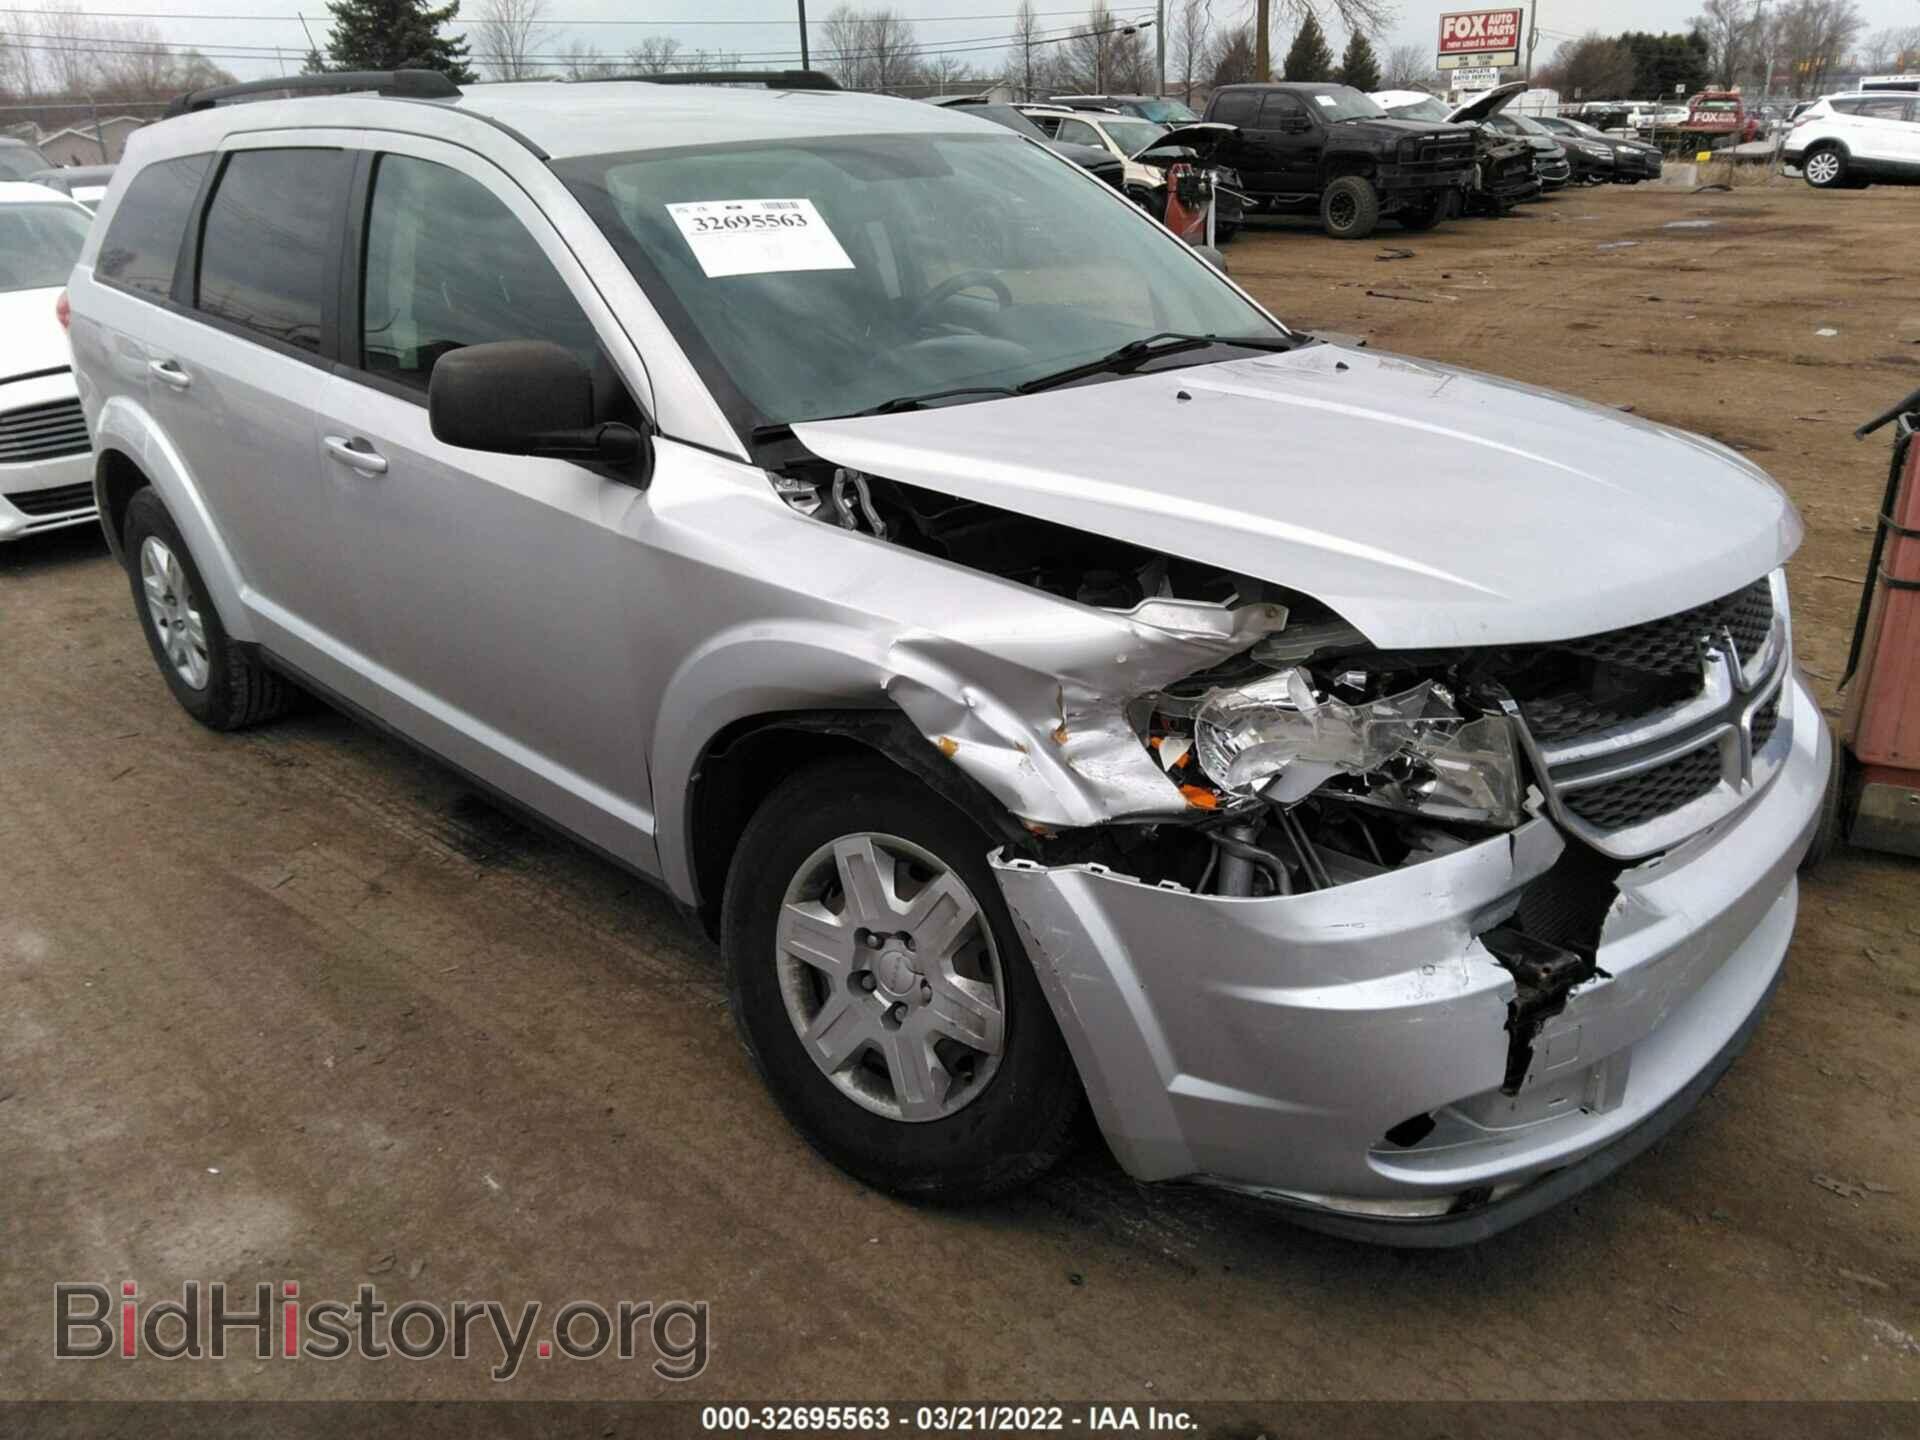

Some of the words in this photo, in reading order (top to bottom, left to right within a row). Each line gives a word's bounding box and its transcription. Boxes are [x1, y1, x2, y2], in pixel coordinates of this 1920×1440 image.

[1488, 13, 1513, 25] AUTO
[1443, 15, 1486, 39] FOX
[1487, 24, 1515, 36] PARTS
[1462, 39, 1479, 48] used
[1693, 111, 1718, 122] FOX
[692, 212, 808, 231] 32695563
